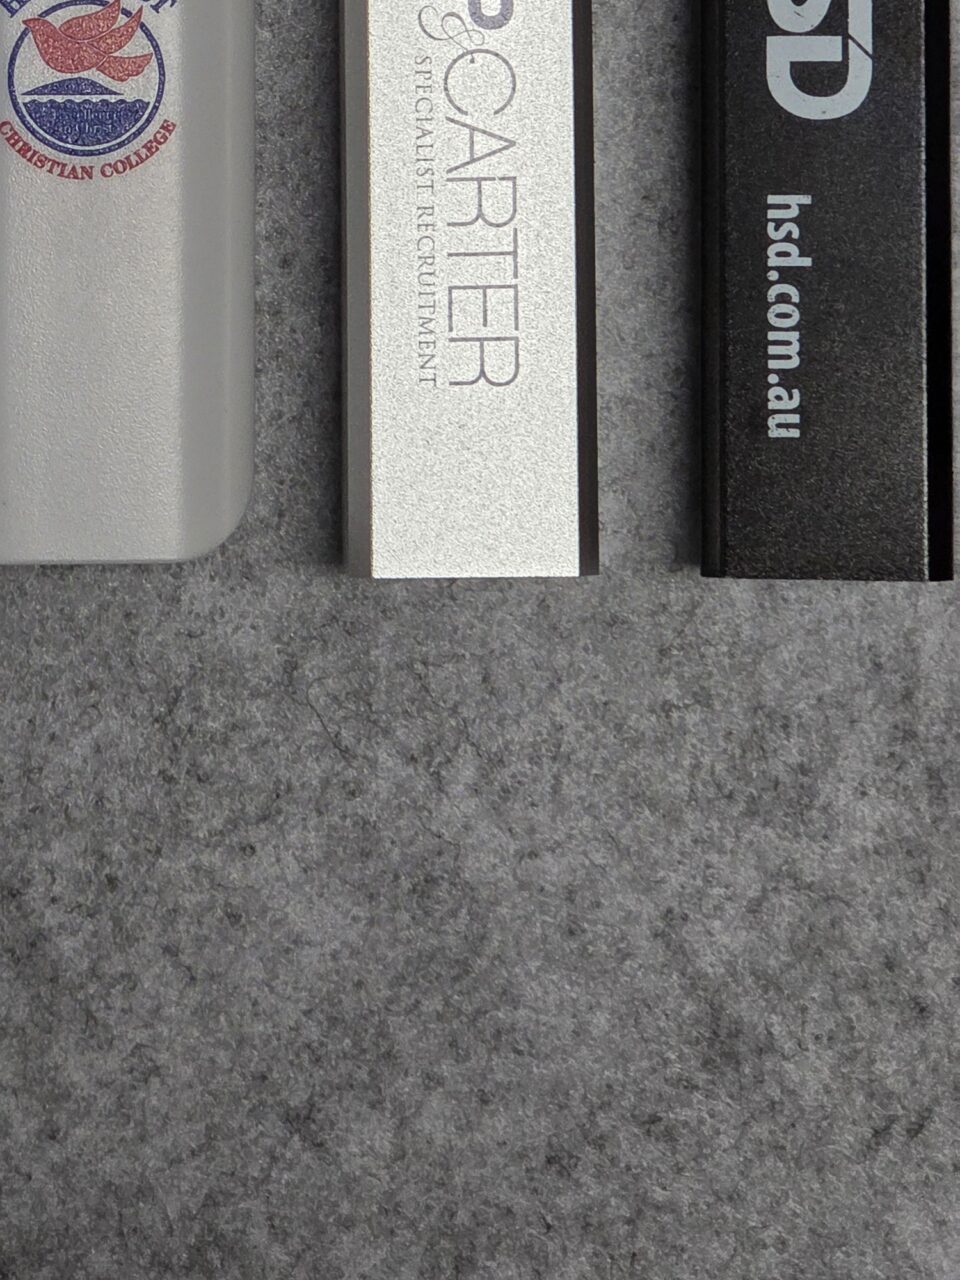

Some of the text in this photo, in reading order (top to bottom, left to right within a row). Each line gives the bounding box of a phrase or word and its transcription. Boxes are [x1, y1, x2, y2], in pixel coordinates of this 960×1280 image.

[100, 119, 177, 178] COLLEGE
[415, 55, 438, 388] SPECIALIST RECRUITMENT
[444, 48, 520, 387] CARTER
[767, 194, 812, 438] hsd.com.au
